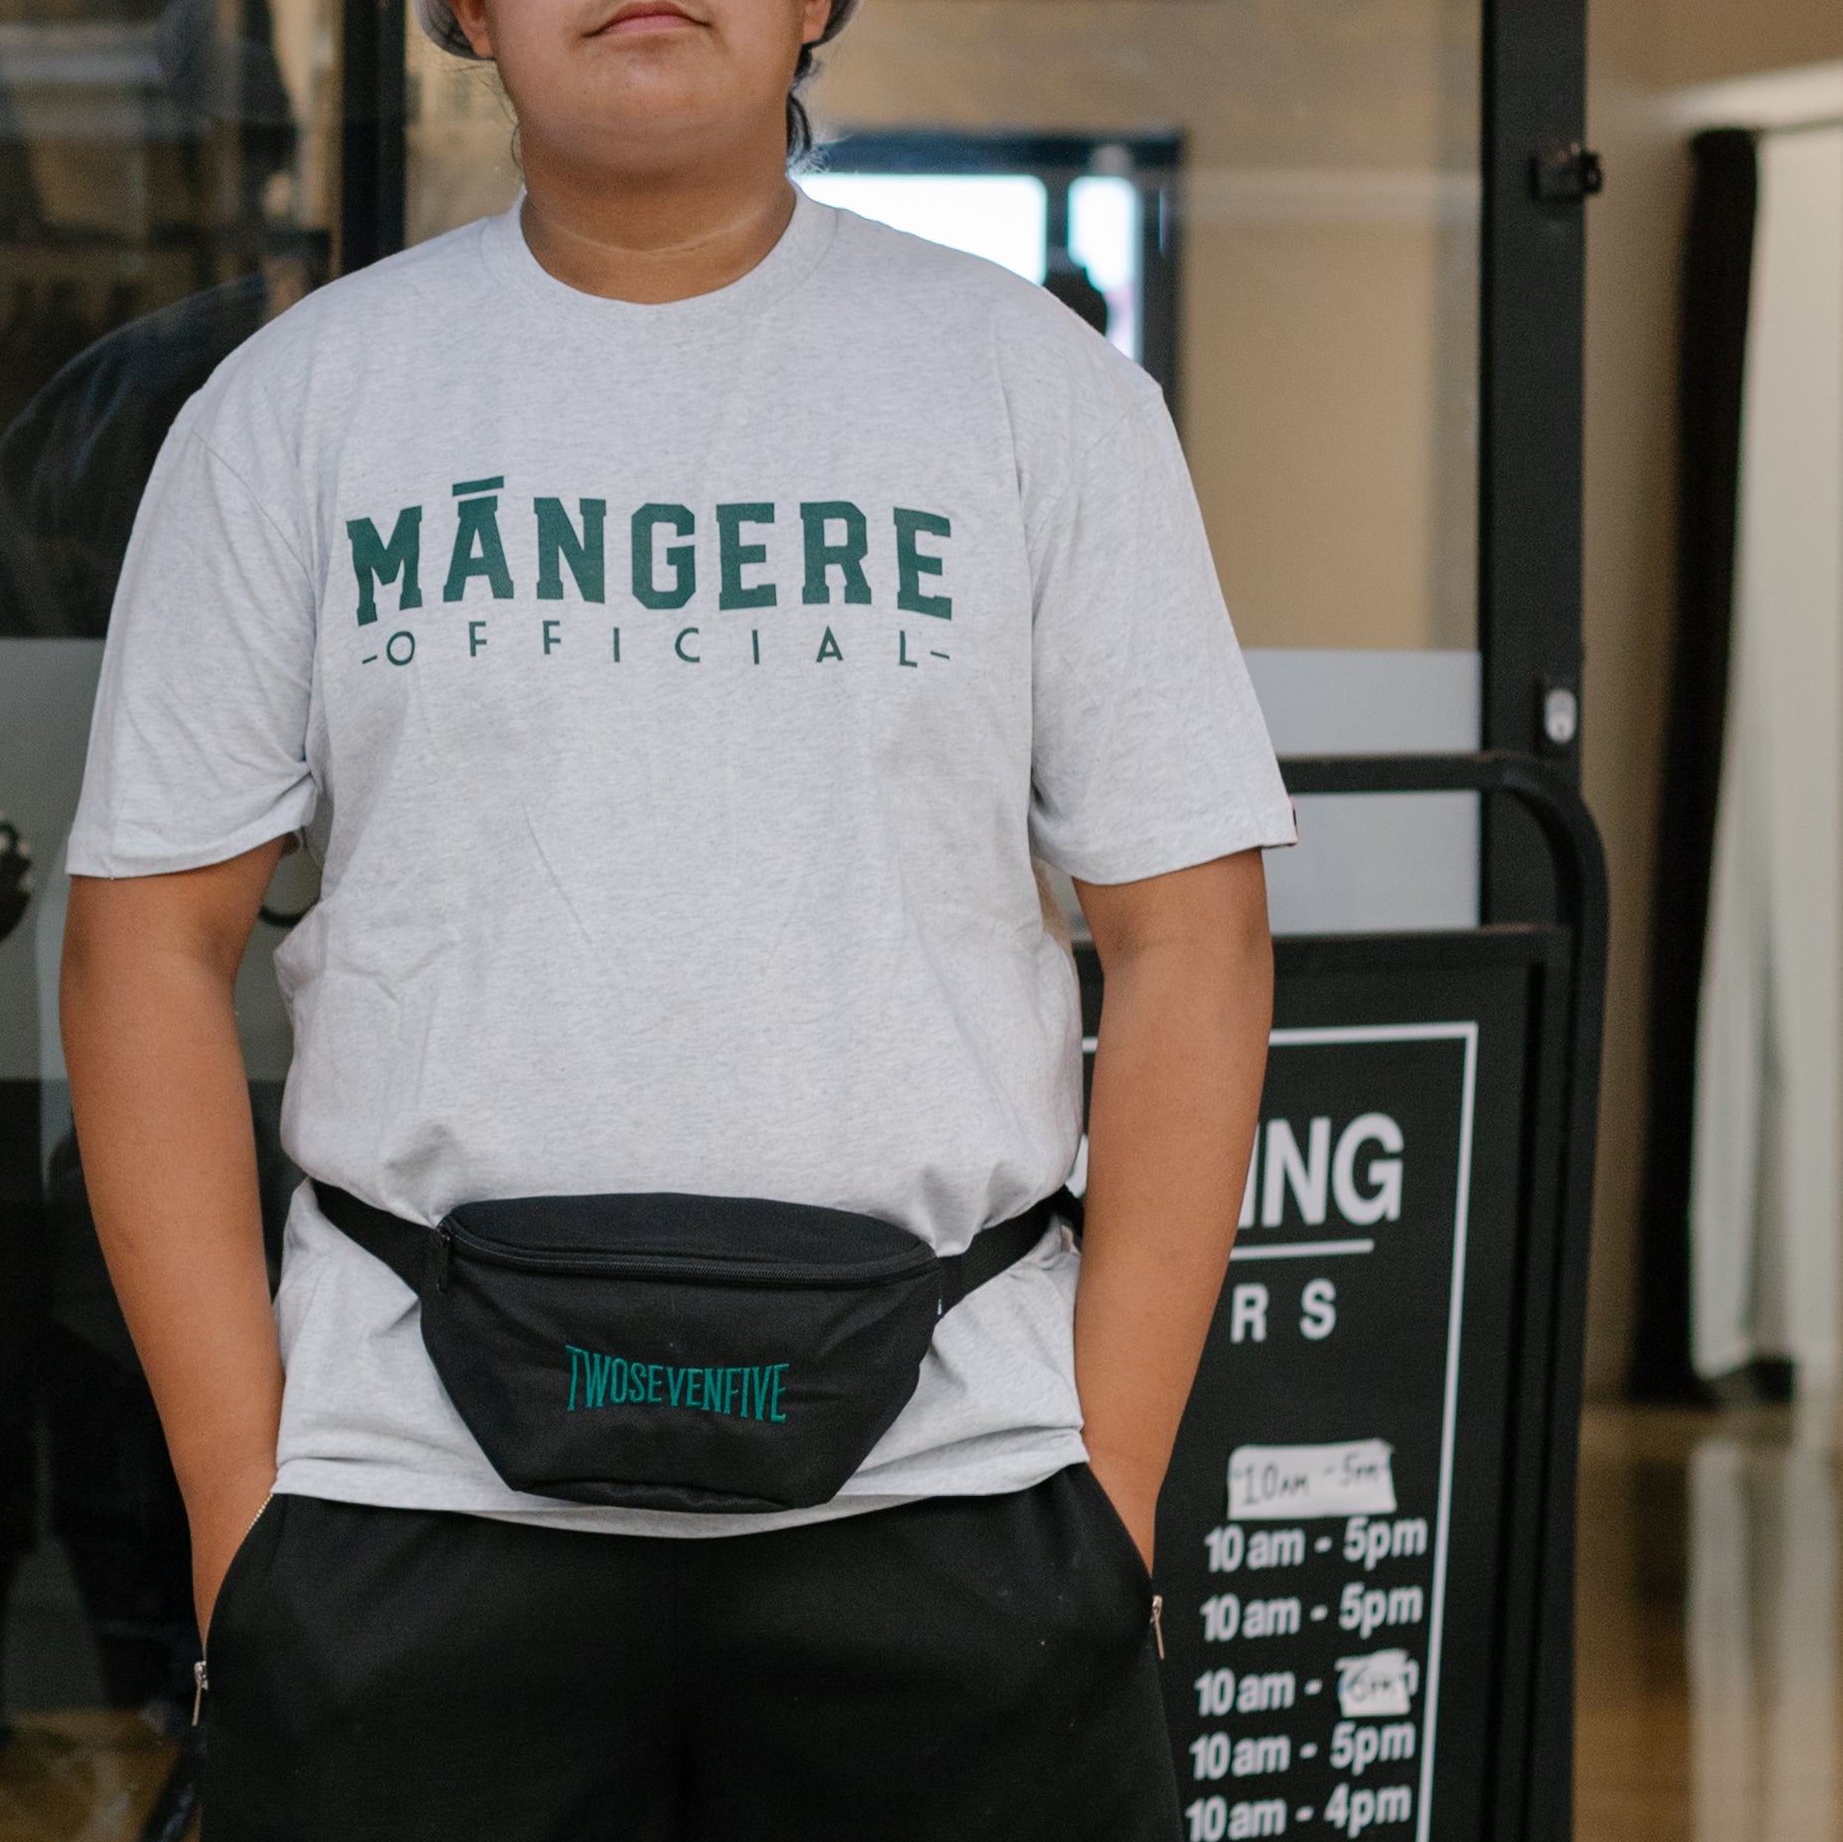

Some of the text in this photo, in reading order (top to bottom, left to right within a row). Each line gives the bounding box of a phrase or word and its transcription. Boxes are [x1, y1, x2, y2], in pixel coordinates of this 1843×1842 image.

[346, 475, 952, 626] MĀNGERE
[564, 1344, 790, 1424] TWOSEVENFIVE
[1343, 1515, 1428, 1572] 5pm
[1338, 1580, 1424, 1640] 5pm
[1329, 1720, 1416, 1776] 5pm
[1323, 1781, 1412, 1840] 4pm
